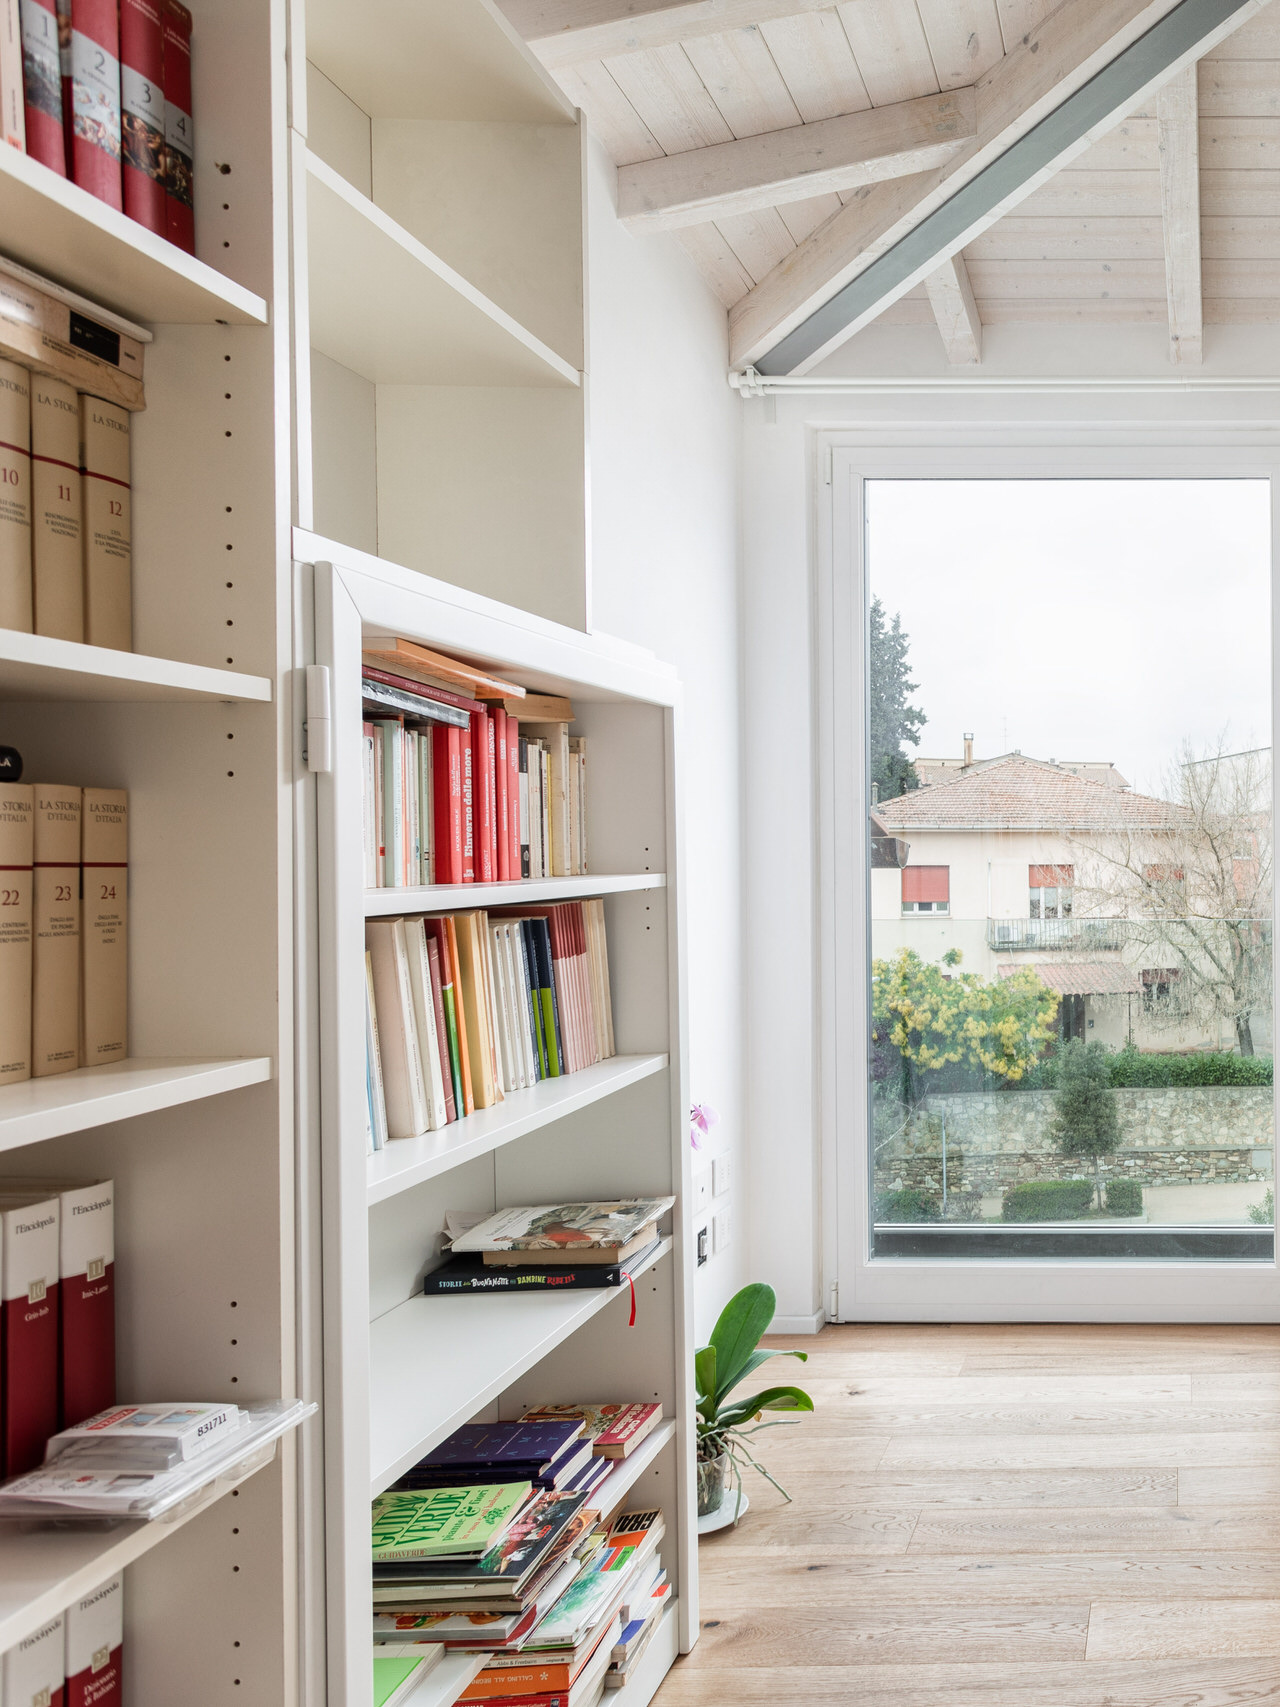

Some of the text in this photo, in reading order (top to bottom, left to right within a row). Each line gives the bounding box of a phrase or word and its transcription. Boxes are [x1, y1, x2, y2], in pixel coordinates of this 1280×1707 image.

[41, 15, 48, 37] 1
[95, 51, 105, 75] 2
[141, 83, 151, 103] 3
[176, 117, 186, 137] 4
[38, 394, 51, 406] LA
[93, 414, 104, 425] LA
[2, 467, 19, 486] 10
[58, 485, 71, 501] 11
[109, 500, 122, 517] 12
[40, 801, 52, 810] LA
[90, 804, 126, 814] LA STORIA
[463, 748, 473, 857] L'inverno delle more
[48, 812, 76, 822] D'ITALIA
[96, 815, 122, 823] D'ITALIA
[2, 890, 19, 906] 22
[55, 885, 71, 901] 23
[101, 885, 116, 899] 24
[517, 1275, 545, 1284] BAMBINE
[31, 1282, 44, 1300] 10
[197, 1413, 227, 1437] 831711
[394, 1490, 470, 1546] VERDE
[442, 1489, 489, 1541] piante & fiori
[507, 1674, 533, 1682] CALLING
